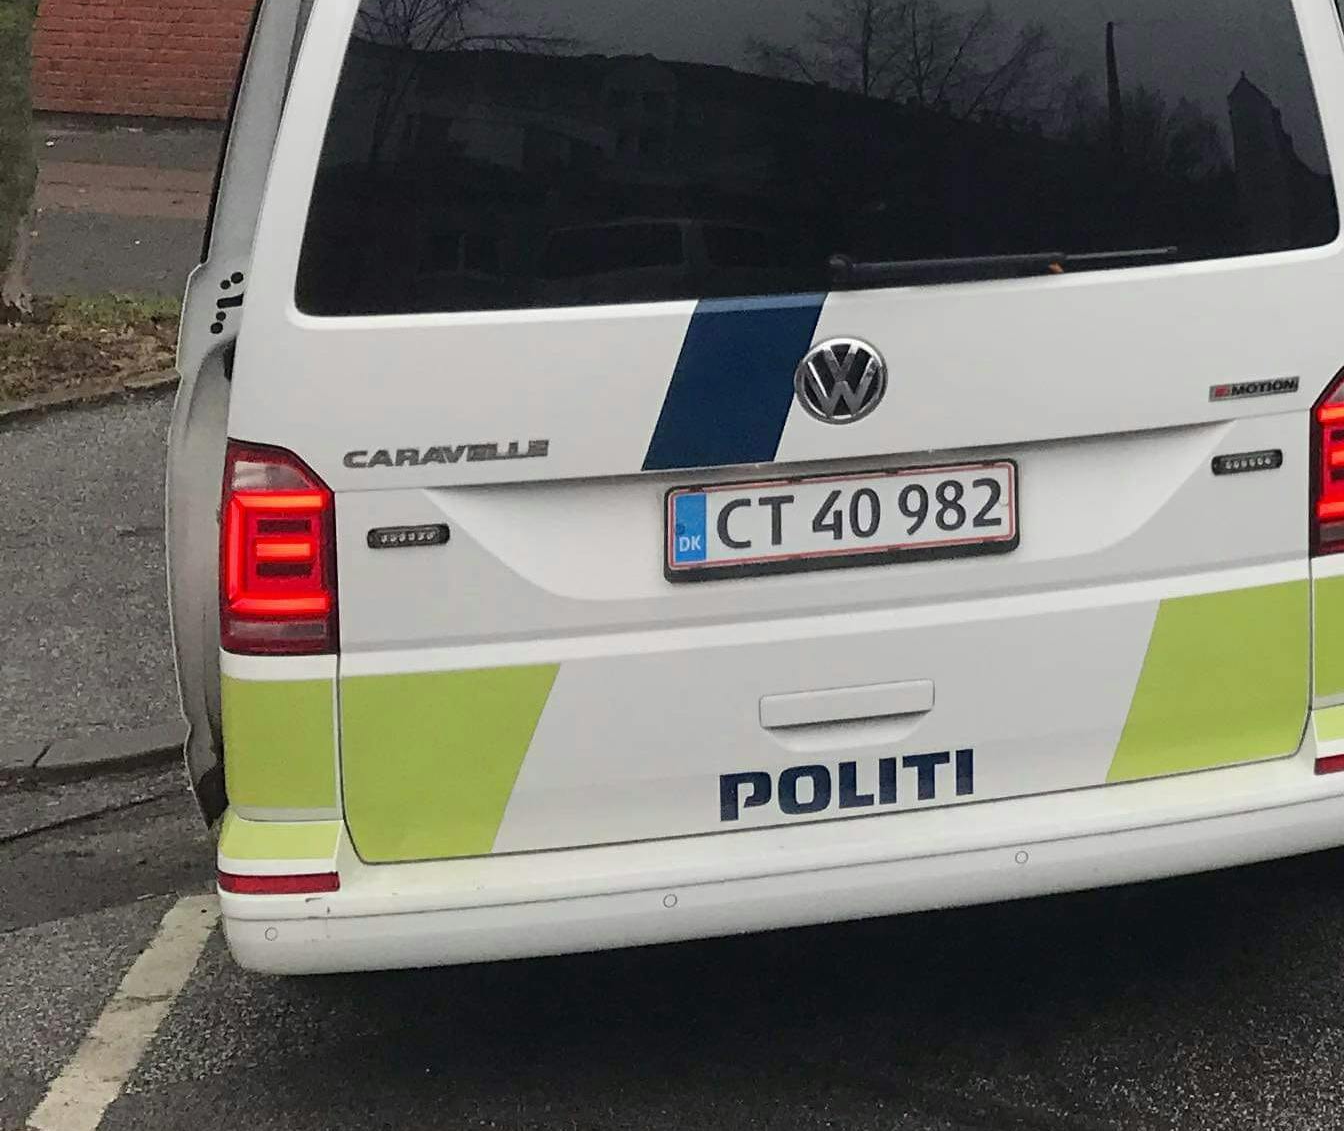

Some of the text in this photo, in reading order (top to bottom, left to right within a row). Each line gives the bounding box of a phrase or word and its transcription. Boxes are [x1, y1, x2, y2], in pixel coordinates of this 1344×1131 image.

[343, 439, 550, 469] CARAVELLE
[716, 477, 1003, 549] CT 40 982
[679, 535, 702, 552] DK
[719, 748, 975, 822] POLITI
